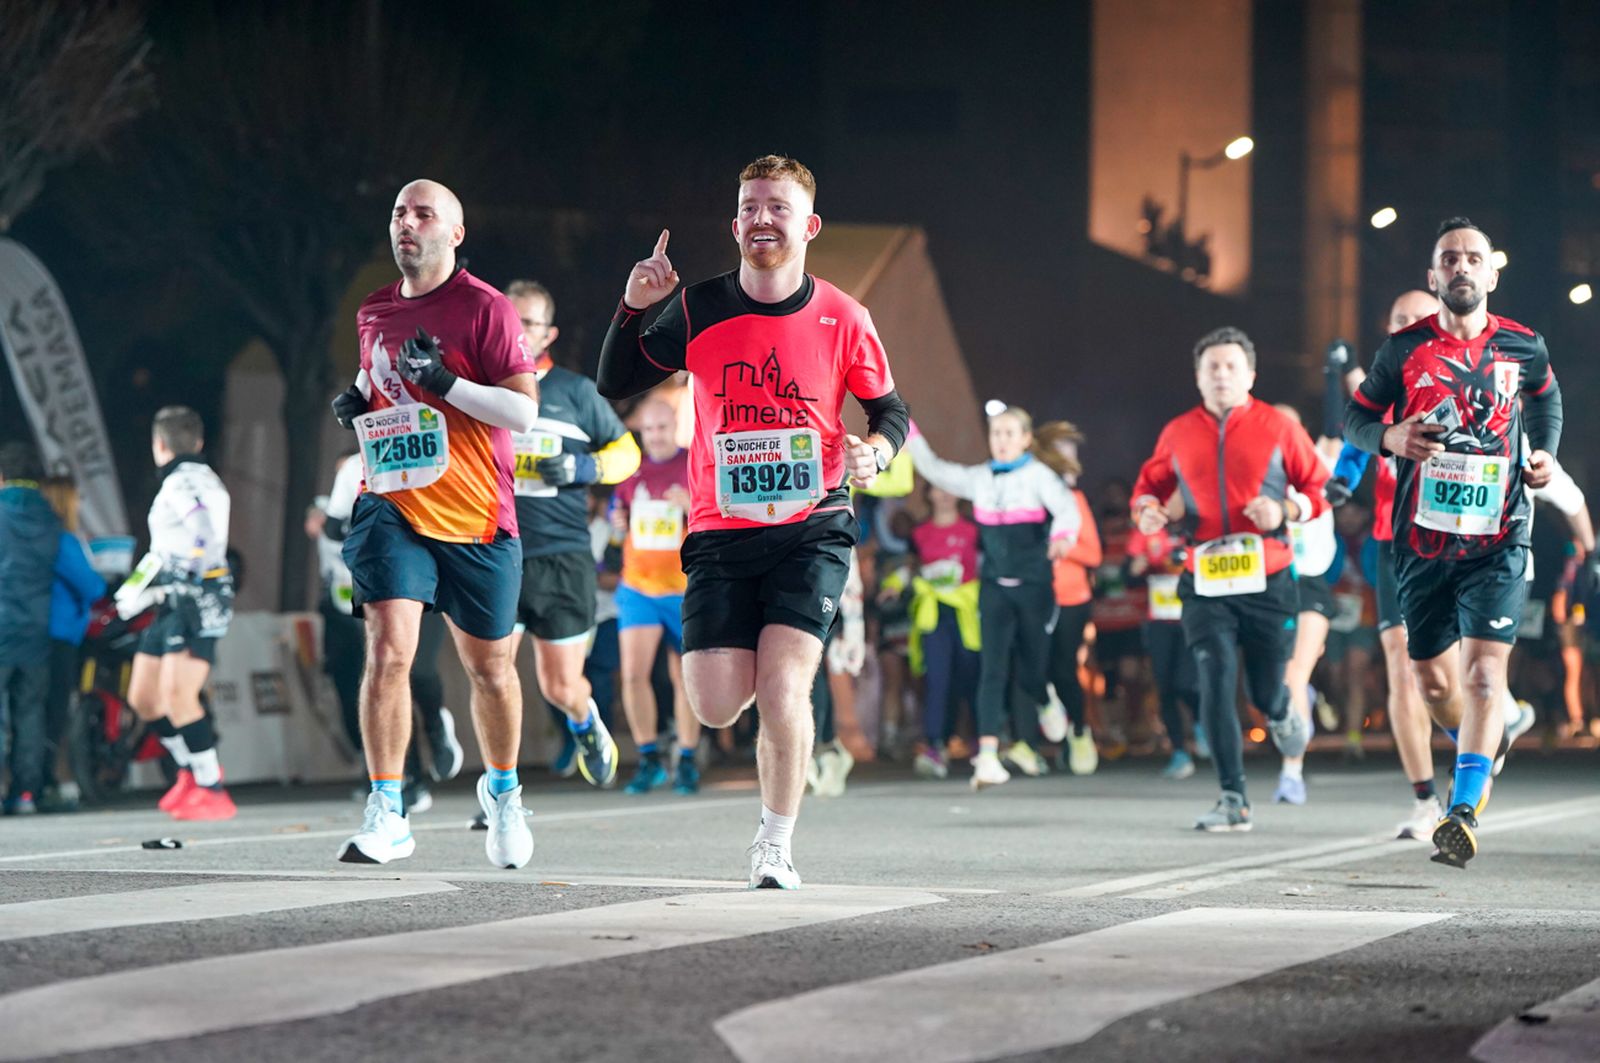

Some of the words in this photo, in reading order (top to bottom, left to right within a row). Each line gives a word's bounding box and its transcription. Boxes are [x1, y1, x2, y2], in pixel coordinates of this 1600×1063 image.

[721, 399, 809, 428] jimena
[376, 416, 400, 426] NOCHE
[401, 414, 410, 423] DE
[368, 429, 385, 440] SAN
[371, 432, 437, 464] 12586
[737, 441, 767, 452] NOCHE
[769, 440, 781, 449] DE
[727, 454, 746, 465] SAN
[1440, 462, 1465, 472] NOCHE
[728, 462, 810, 494] 13926
[1430, 470, 1447, 479] SAN
[1434, 481, 1489, 507] 9230
[1208, 555, 1251, 574] 5000
